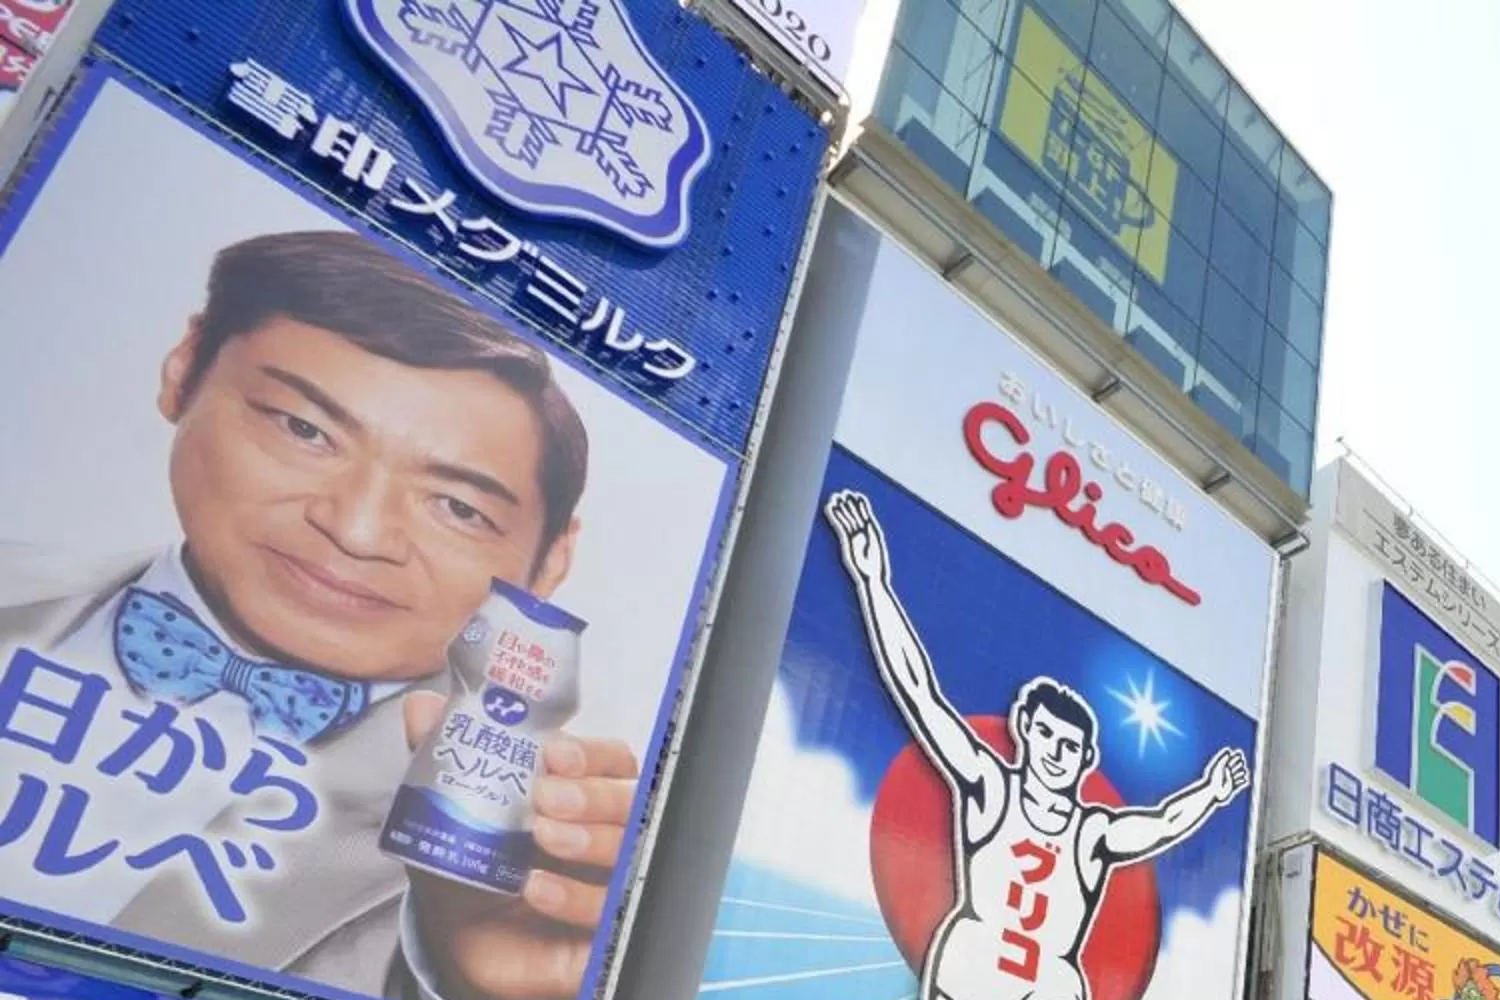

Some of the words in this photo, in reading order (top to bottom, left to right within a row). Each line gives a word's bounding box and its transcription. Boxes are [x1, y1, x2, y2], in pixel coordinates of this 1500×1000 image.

[228, 57, 697, 382] 雪印メグミルク
[444, 712, 539, 773] 乳酸菌
[997, 838, 1062, 984] グリコ
[1346, 885, 1430, 953] かぜに
